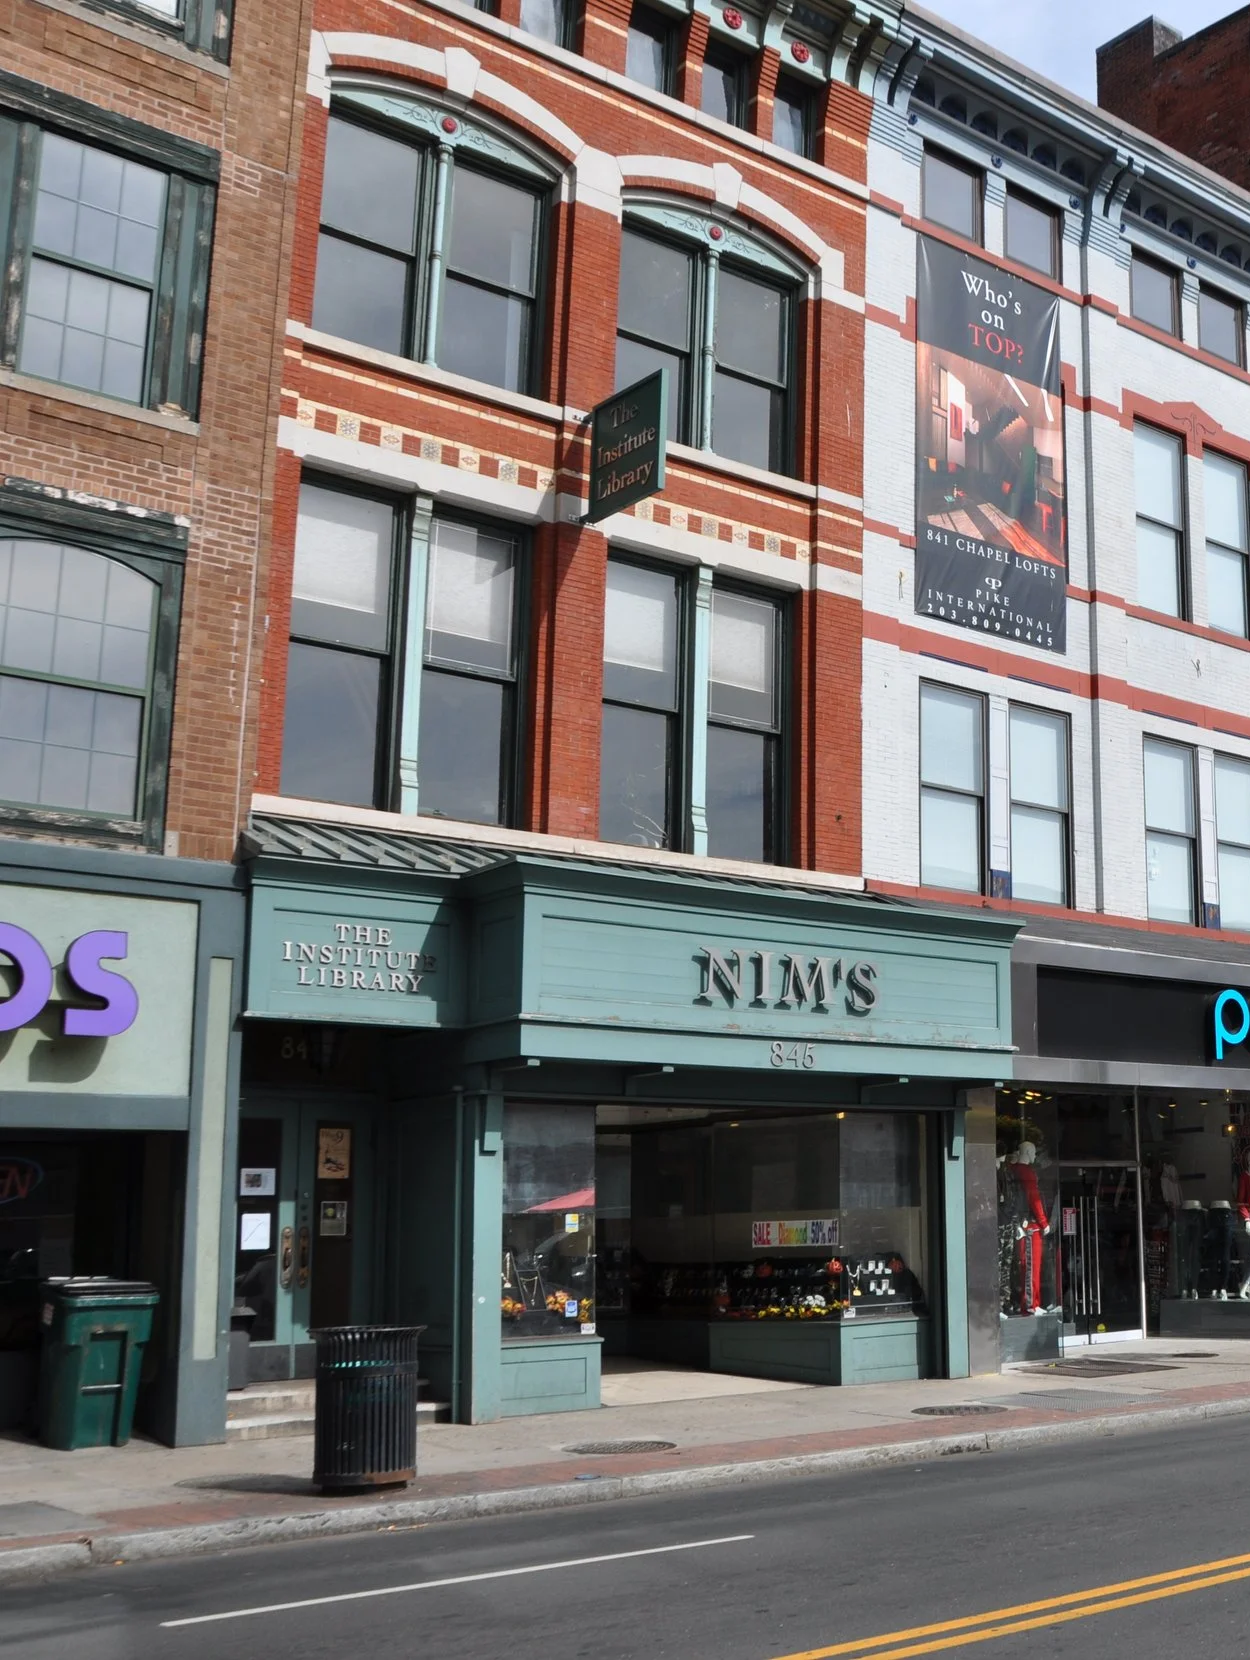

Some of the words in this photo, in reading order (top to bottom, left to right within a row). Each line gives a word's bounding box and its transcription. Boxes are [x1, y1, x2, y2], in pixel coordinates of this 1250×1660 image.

[960, 270, 1022, 315] Who's
[981, 309, 1005, 331] on
[968, 323, 1024, 364] TOP?
[610, 402, 639, 428] The
[597, 426, 656, 469] Institute
[597, 460, 654, 500] Library
[926, 529, 949, 546] 841
[955, 538, 1011, 565] CHAPEL
[1015, 556, 1056, 580] LOFTS
[927, 588, 1053, 633] INTERNATIONAL
[976, 588, 1010, 607] PIKE
[927, 603, 1053, 647] 203.809.0445
[334, 923, 393, 946] THE
[283, 941, 438, 972] INSTITUTE
[297, 966, 424, 993] LIBRARY
[698, 946, 882, 1011] NIM'S
[770, 1040, 817, 1068] 845
[753, 1222, 771, 1245] SALE
[810, 1220, 827, 1244] 50%
[827, 1220, 838, 1243] off
